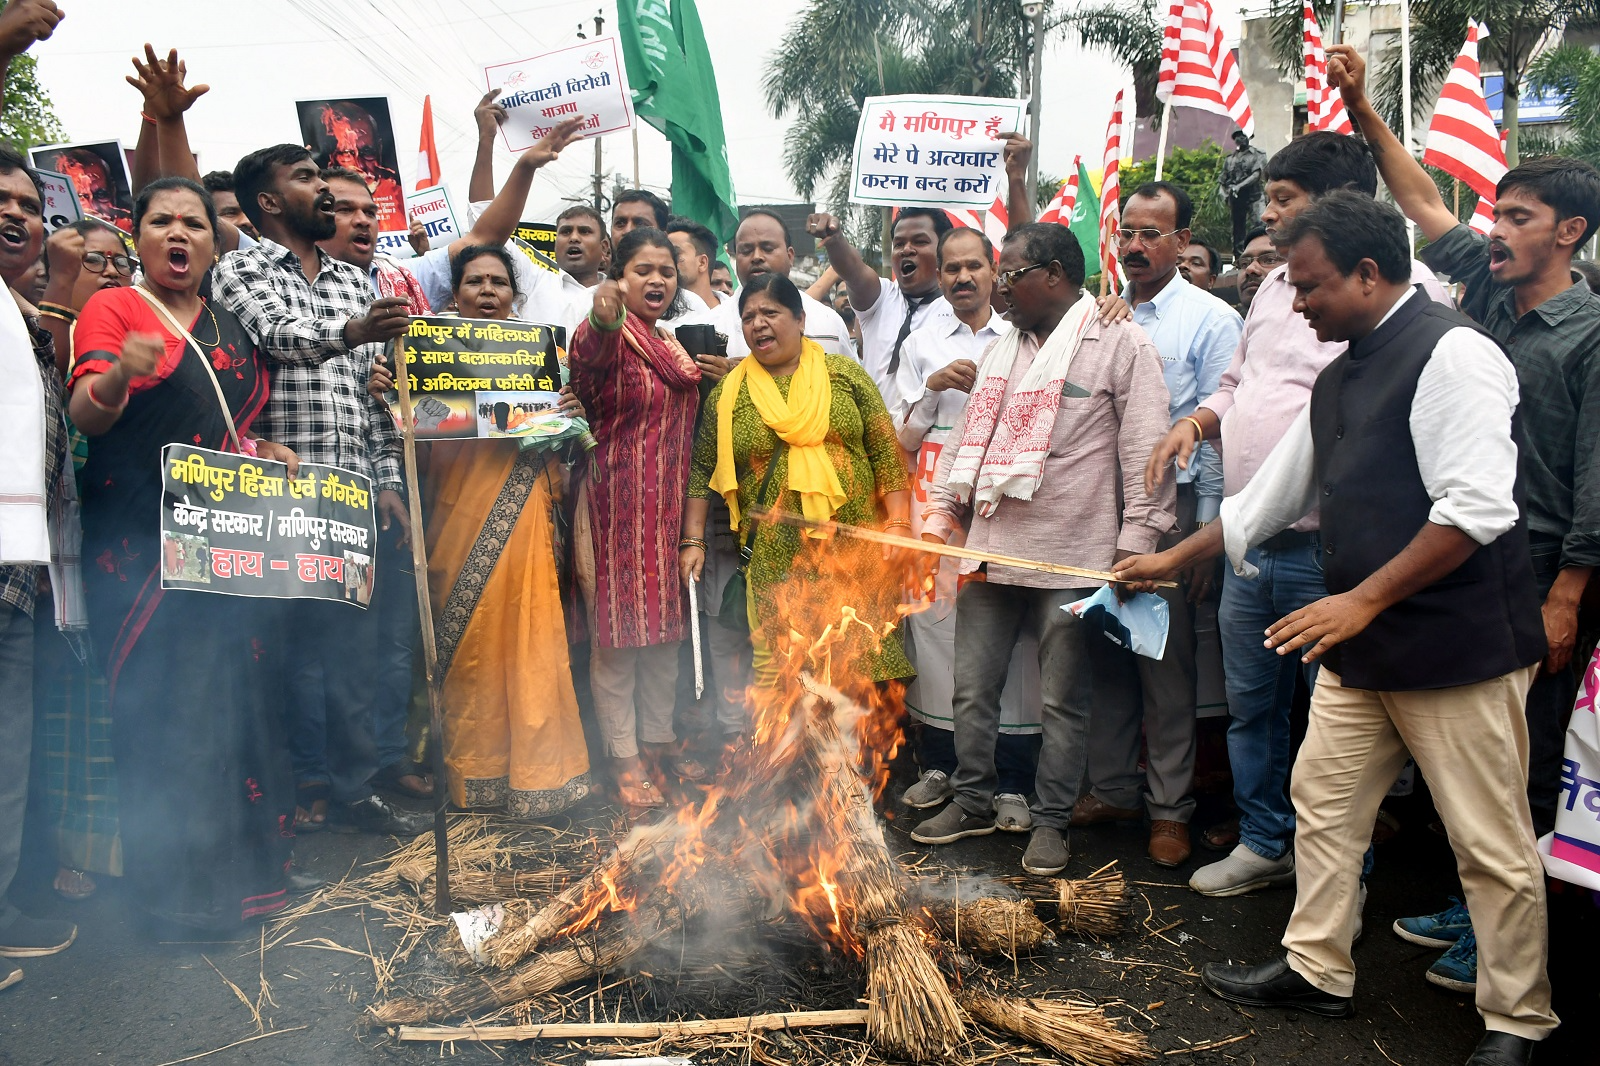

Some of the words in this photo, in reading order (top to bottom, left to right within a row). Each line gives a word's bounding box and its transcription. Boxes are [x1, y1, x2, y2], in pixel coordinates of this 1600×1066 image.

[499, 82, 562, 110] आदिवासी
[566, 71, 611, 94] विरोधी
[541, 101, 578, 118] भाजपा
[904, 111, 978, 140] मणिपुर
[873, 143, 900, 163] मेरे
[905, 144, 920, 165] पे
[926, 151, 999, 168] अत्यचार
[862, 174, 909, 190] करना
[915, 176, 948, 192] बन्द
[954, 174, 992, 193] करों
[408, 198, 447, 216] तंकवाद
[518, 228, 557, 242] सरका
[456, 322, 473, 339] में
[474, 324, 541, 342] महिलाओं
[421, 350, 455, 364] साथ
[458, 350, 546, 366] बलात्कारियों
[421, 372, 493, 391] अभिलम्ब
[538, 375, 554, 391] दो
[170, 453, 236, 501] मणिपुर
[238, 463, 283, 497] हिंसा
[289, 472, 316, 499] एवं
[320, 473, 369, 509] गैंगरेप
[173, 495, 209, 533] केन्द्र
[211, 508, 263, 537] सरकार
[277, 507, 327, 550] मणिपुर
[329, 519, 368, 548] सरकार
[210, 547, 264, 578] हाय
[295, 553, 344, 583] हाय
